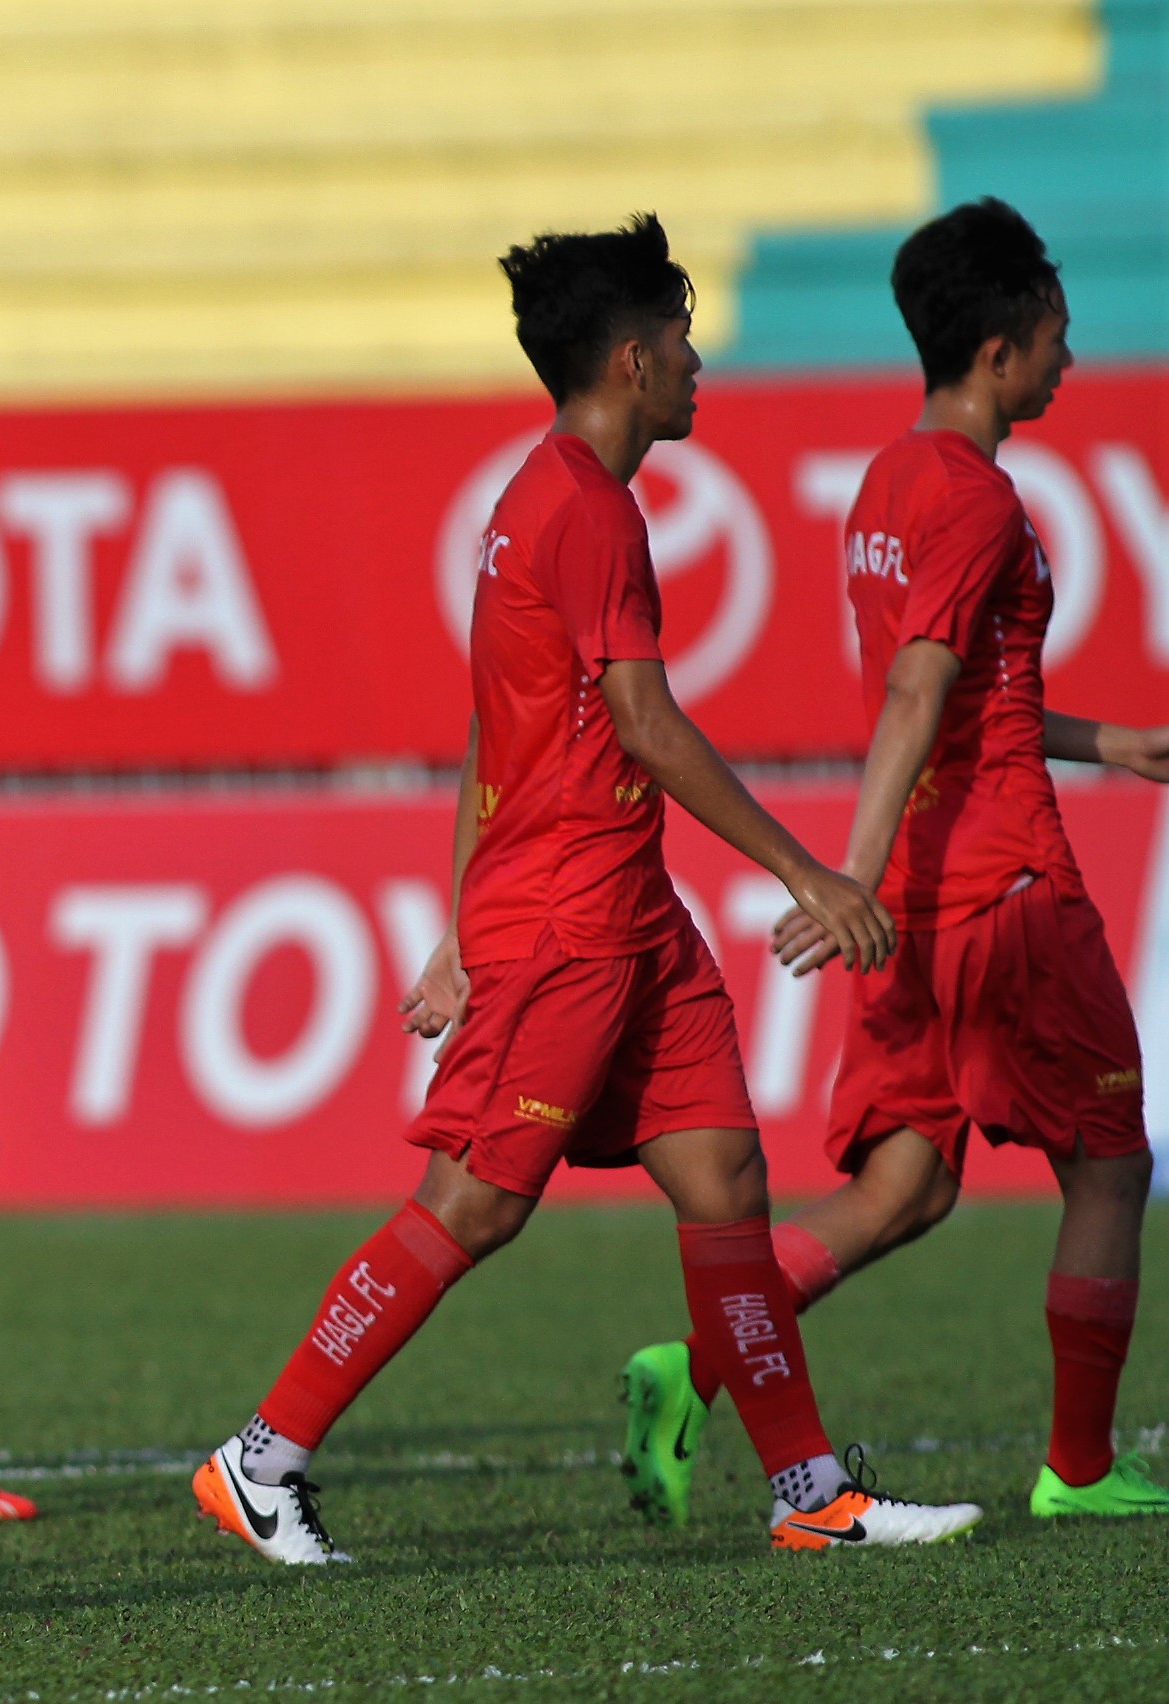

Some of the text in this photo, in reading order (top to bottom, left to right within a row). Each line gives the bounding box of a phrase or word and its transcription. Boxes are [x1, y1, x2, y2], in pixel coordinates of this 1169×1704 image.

[311, 1261, 396, 1368] HAGL FC
[720, 1293, 791, 1386] HAGL FC
